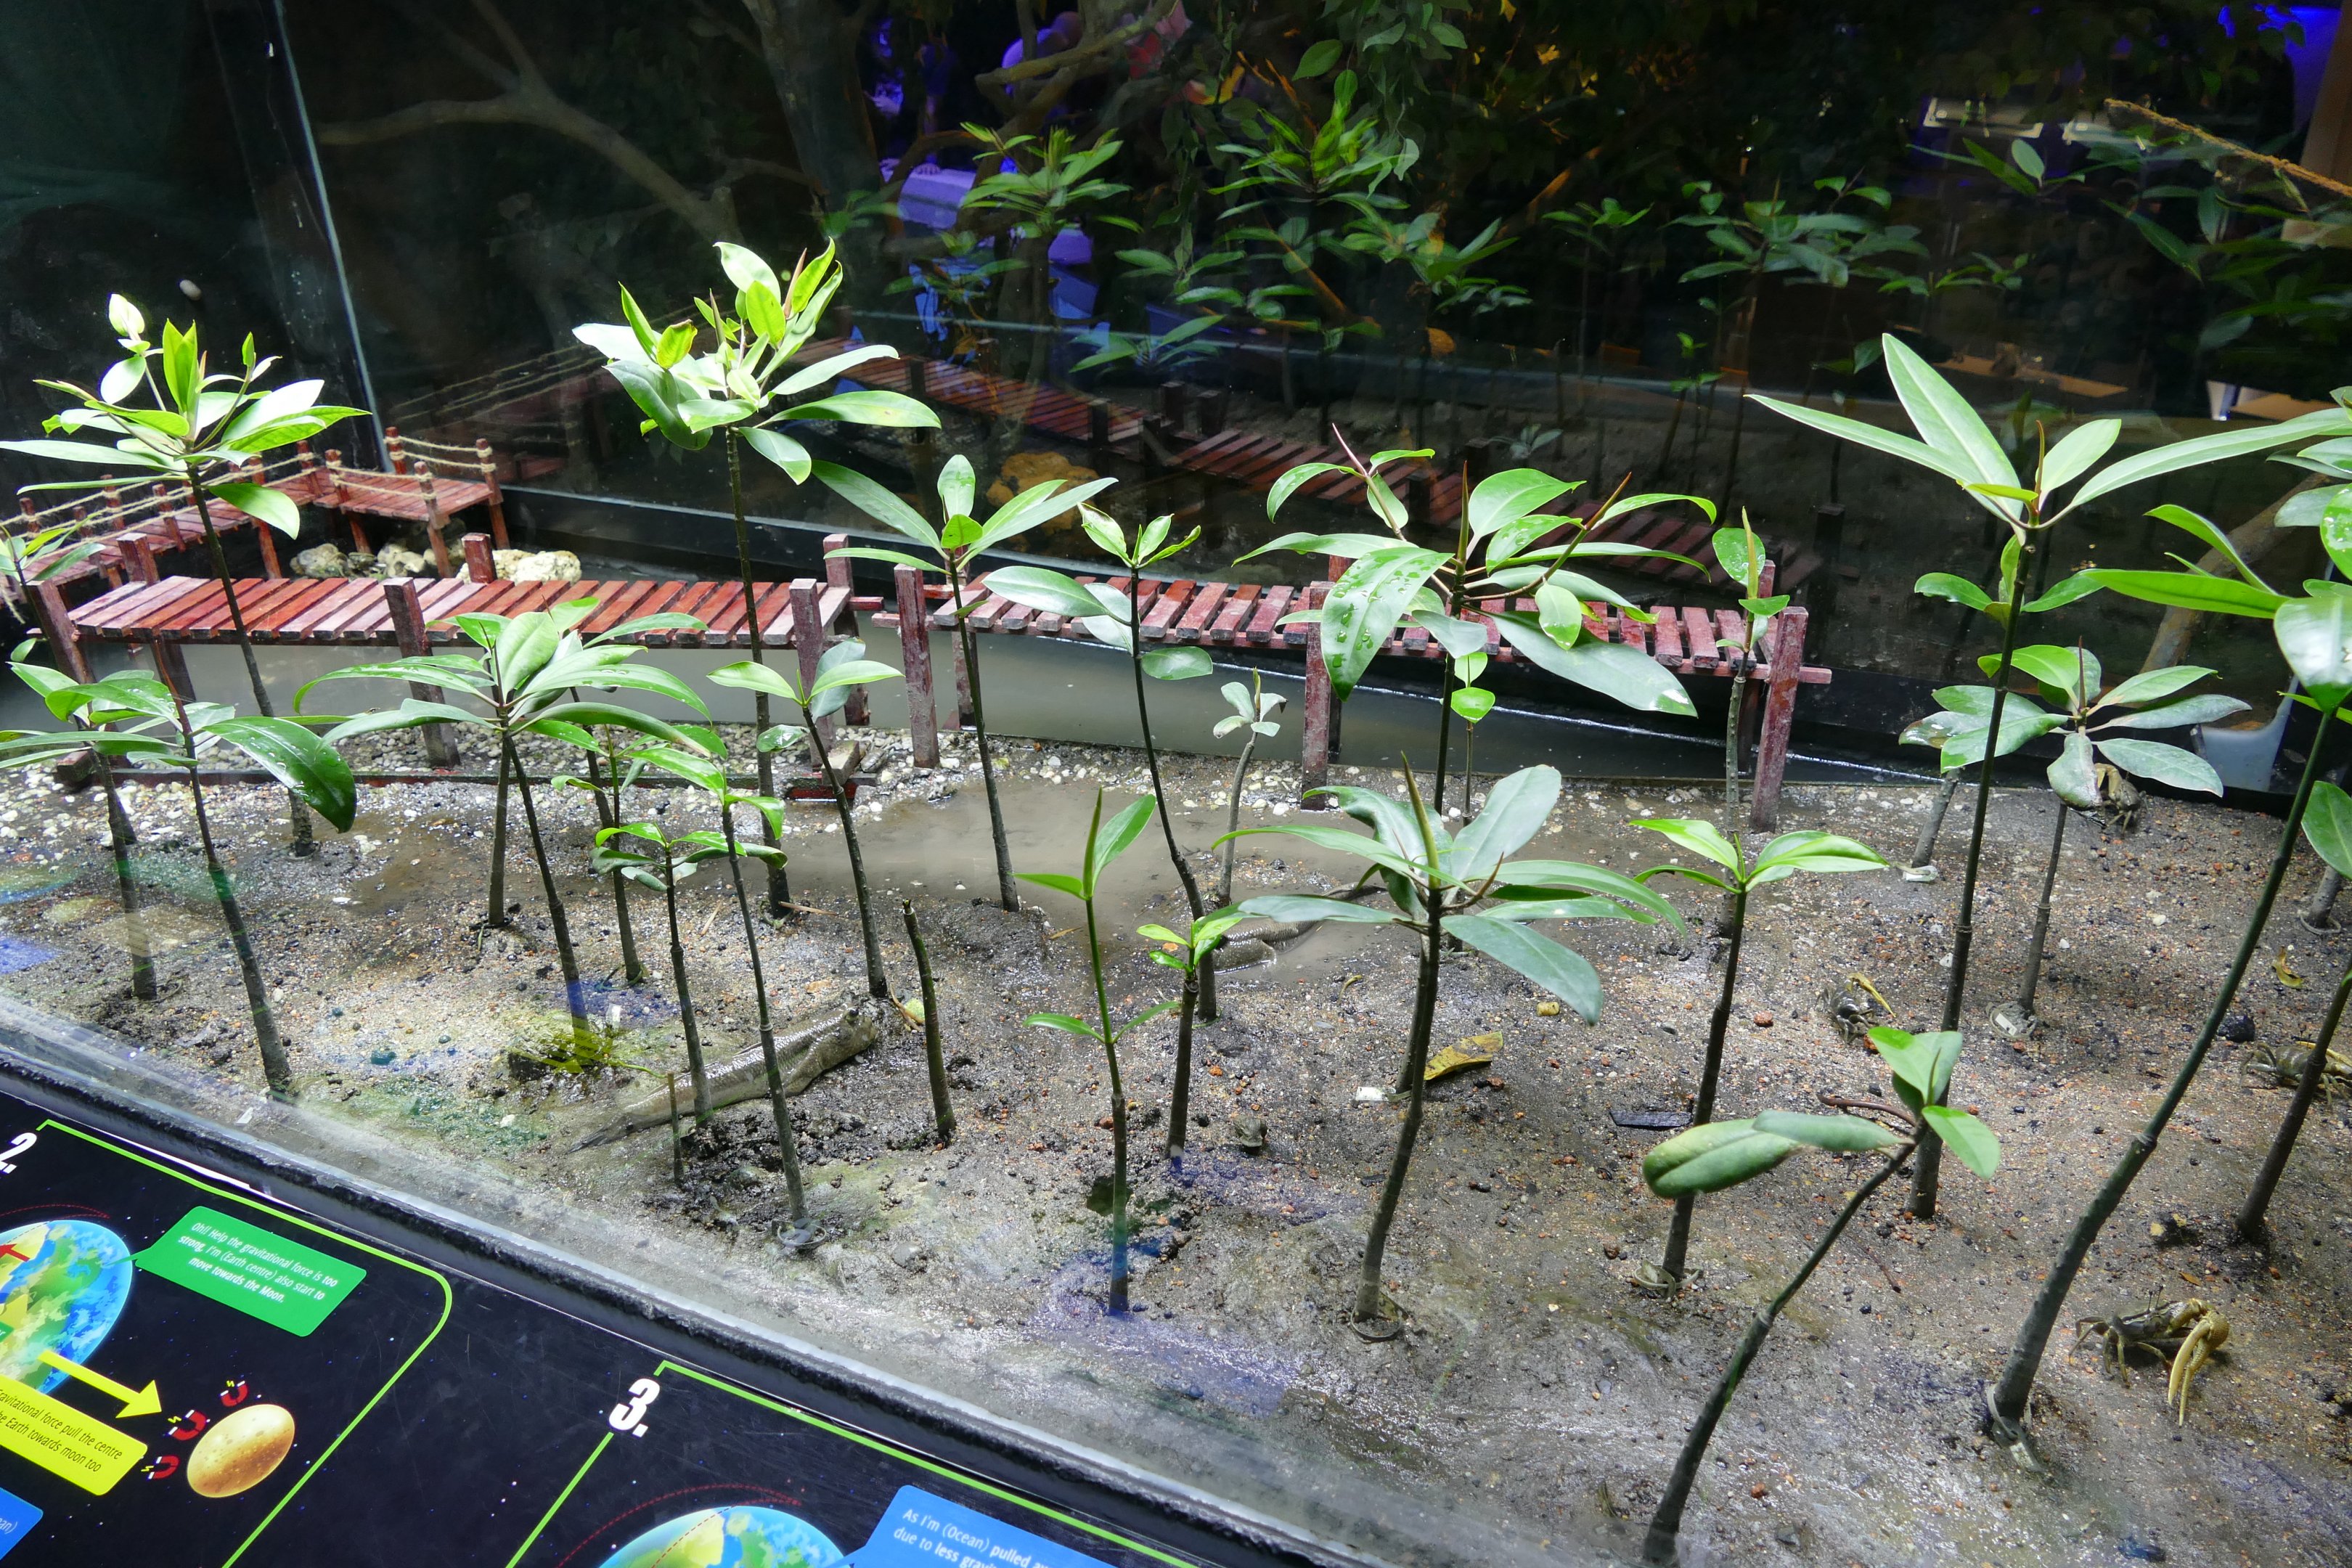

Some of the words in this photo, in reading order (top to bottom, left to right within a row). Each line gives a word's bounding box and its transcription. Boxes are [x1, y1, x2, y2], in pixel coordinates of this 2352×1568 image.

[188, 1257, 212, 1272] move
[211, 1264, 245, 1286] towards
[244, 1278, 261, 1292] the
[258, 1286, 285, 1303] Moon.
[191, 1222, 211, 1235] Oh!!
[208, 1228, 229, 1242] Help
[226, 1236, 243, 1249] the
[240, 1243, 294, 1269] gravitational
[289, 1261, 313, 1277] force
[312, 1272, 322, 1281] is
[322, 1275, 339, 1288] too
[205, 1244, 221, 1258] I'm
[220, 1250, 247, 1268] (Earth
[245, 1263, 277, 1281] centre)
[274, 1274, 293, 1288] also
[293, 1282, 314, 1297] start
[313, 1289, 325, 1301] to
[40, 1409, 63, 1429] force
[60, 1424, 83, 1439] pull
[78, 1432, 95, 1446] the
[94, 1441, 123, 1460] centre
[609, 1378, 660, 1437] 3.
[5, 1417, 30, 1435] Earth
[28, 1428, 62, 1453] towards
[60, 1446, 86, 1464] moon
[85, 1458, 102, 1472] too
[894, 1527, 918, 1545] due
[919, 1537, 934, 1551] to
[934, 1543, 960, 1562] less
[902, 1508, 919, 1523] As
[920, 1515, 940, 1532] I'm
[942, 1522, 990, 1553] (Ocean)
[989, 1545, 1032, 1568] pulled
